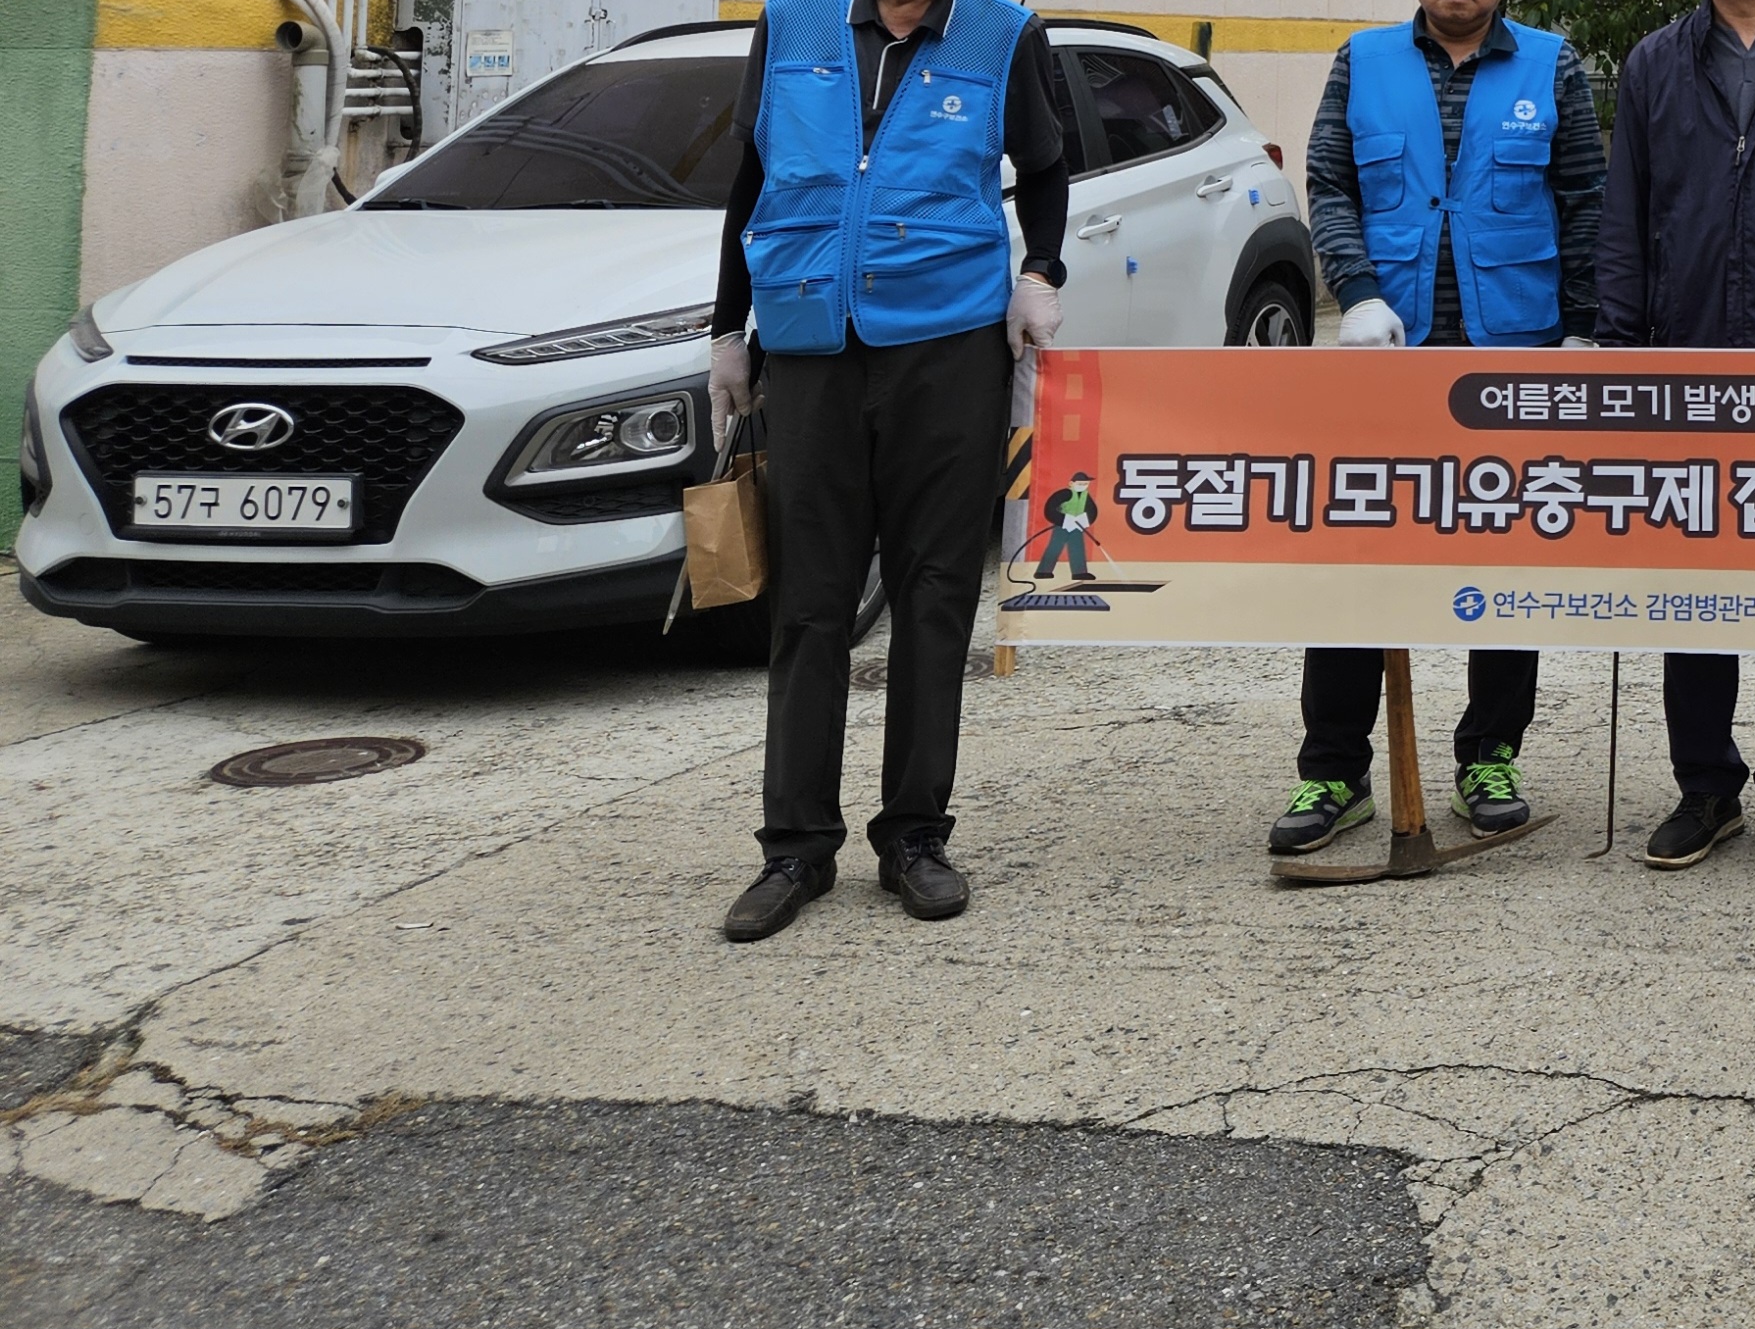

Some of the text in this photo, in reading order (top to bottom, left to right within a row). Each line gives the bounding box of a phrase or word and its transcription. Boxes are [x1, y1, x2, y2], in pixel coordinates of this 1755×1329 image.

[1501, 121, 1547, 131] 연수구보건소
[1480, 383, 1588, 420] 여름철
[1600, 384, 1671, 421] 모기
[1684, 384, 1755, 424] 발생
[154, 484, 331, 521] 57구 6079
[1118, 458, 1310, 529] 동절기
[1328, 460, 1715, 534] 모기유충구제
[1492, 590, 1639, 620] 연수구보건소
